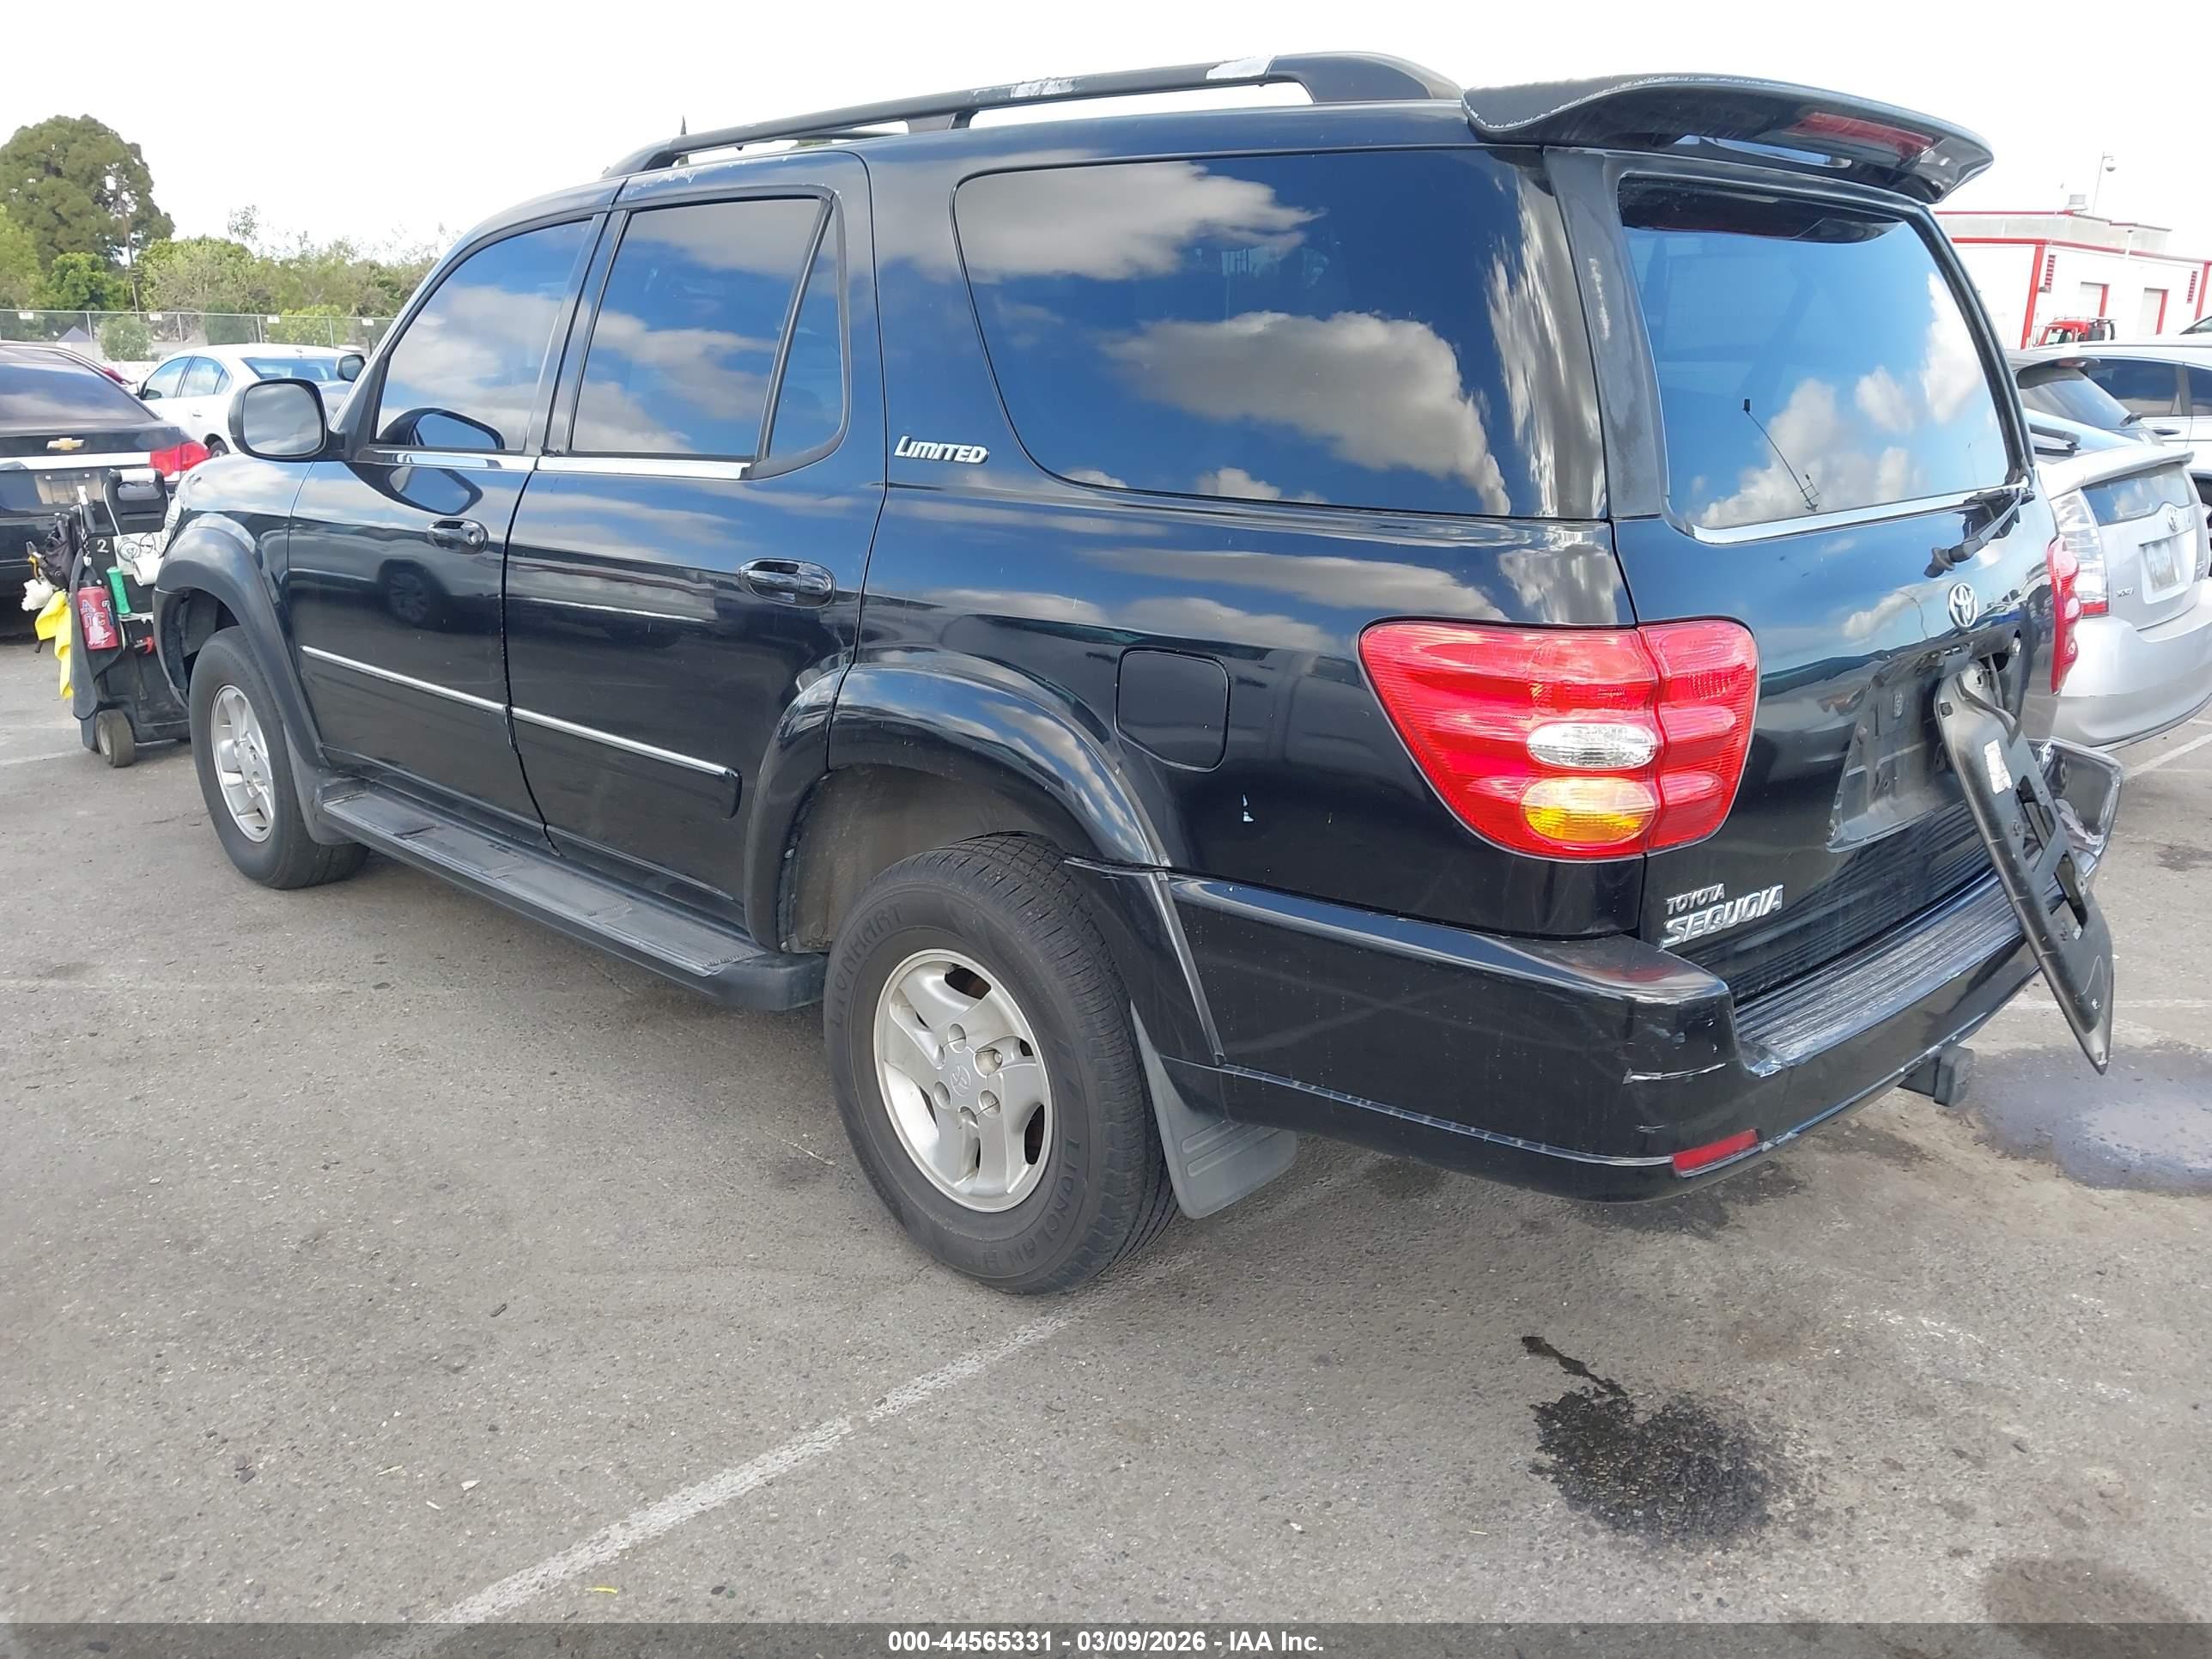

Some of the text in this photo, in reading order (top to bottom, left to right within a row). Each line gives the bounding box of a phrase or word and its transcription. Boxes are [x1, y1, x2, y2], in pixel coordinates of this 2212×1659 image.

[894, 435, 989, 464] LIMITED
[96, 538, 110, 553] 2
[1664, 883, 1725, 915] TOYOTA
[1658, 884, 1784, 950] SEQUOIA
